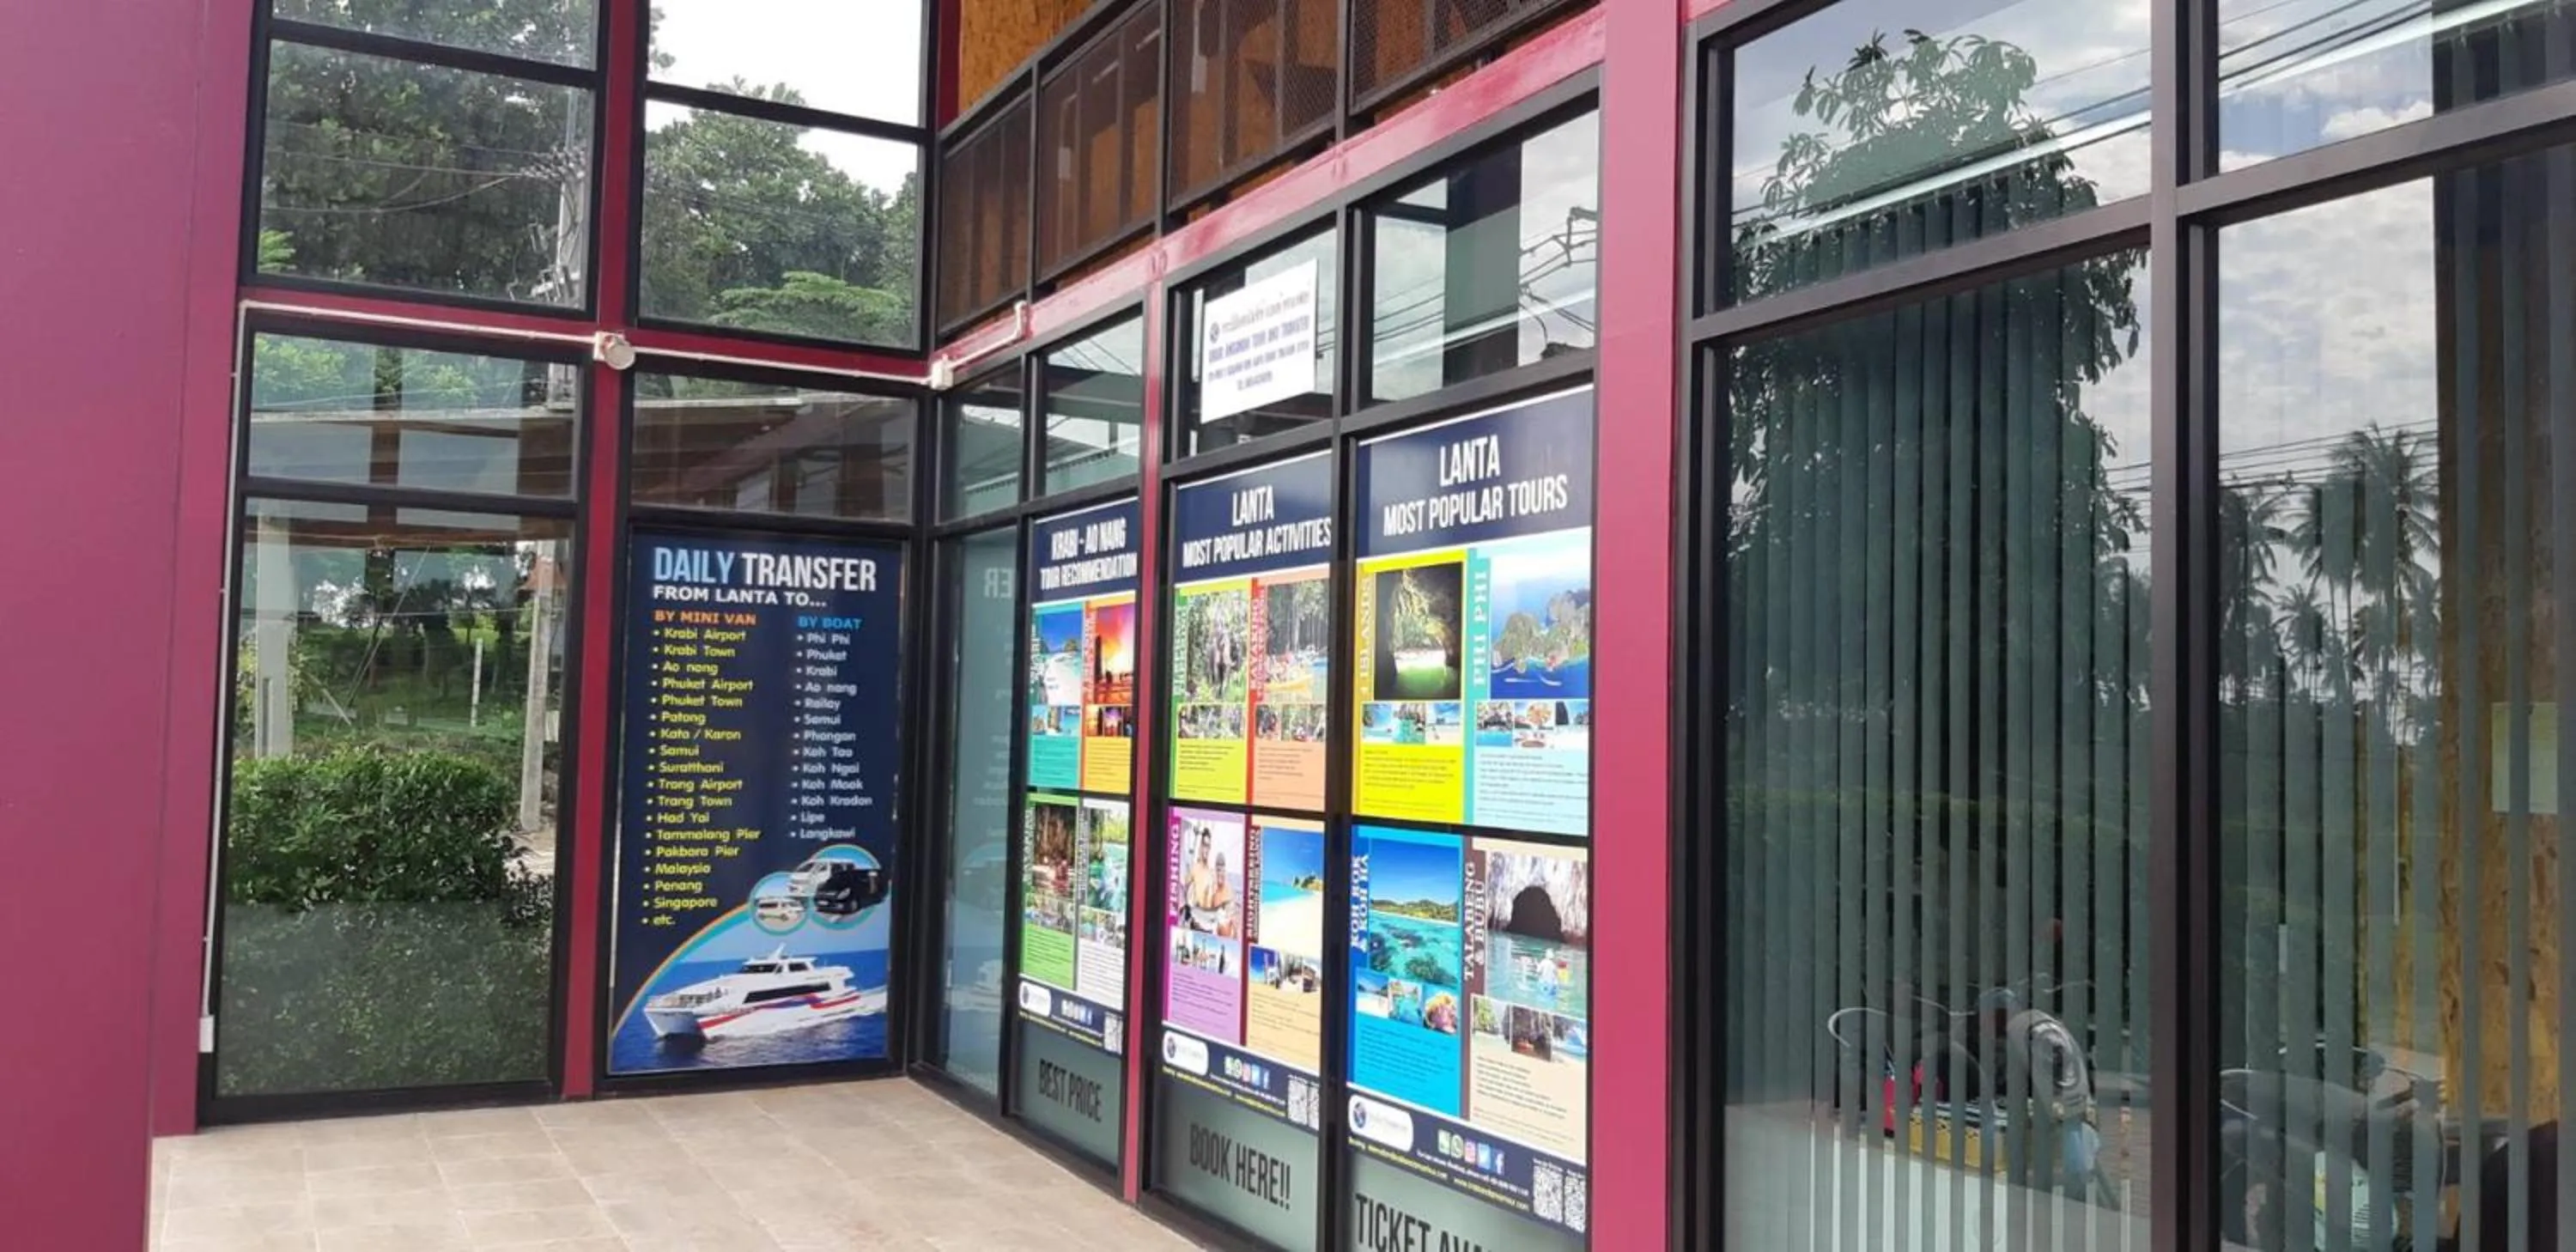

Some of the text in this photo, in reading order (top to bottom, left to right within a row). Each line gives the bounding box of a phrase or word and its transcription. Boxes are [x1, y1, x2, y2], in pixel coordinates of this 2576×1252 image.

[1439, 434, 1500, 487] LANTA
[1232, 484, 1274, 526] LANTA
[1383, 474, 1568, 537] MOST POPULAR TOURS
[1051, 527, 1078, 560] KRABI
[1084, 524, 1098, 555] AO
[1099, 517, 1127, 552] NANG
[1182, 517, 1332, 568] MOST POPULAR ACTIVITIES
[653, 547, 877, 591] DAILY TRANSFER
[1040, 566, 1060, 591] TOUR
[653, 585, 827, 607] FROM LANTA TO...
[654, 611, 756, 625] BY MINI VAN
[798, 617, 862, 629] BY BOAT
[1359, 578, 1372, 678] ISLANDS
[1473, 571, 1487, 685] PHI PHI
[664, 628, 746, 642] Krabi Airport
[806, 633, 850, 645] Phi Phi
[663, 645, 735, 657] Krabi Town
[806, 650, 847, 660] Phuket
[663, 662, 719, 676] Ao nang
[805, 666, 837, 676] Krabi
[663, 678, 753, 692] Phuket Airport
[805, 683, 857, 696] Ao nang
[662, 695, 743, 707] Phuket Town
[805, 698, 841, 710] Railay
[661, 712, 706, 725] Patong
[803, 714, 841, 725] Samui
[660, 729, 690, 739] Kata
[704, 730, 741, 740] Karon
[803, 731, 856, 742] Phangan
[659, 745, 700, 756] Samui
[802, 747, 853, 757] Koh Tao
[659, 763, 724, 773] Suratthani
[802, 763, 860, 775] Koh Ngai
[659, 780, 743, 792] Trang Airport
[801, 780, 824, 789] Koh
[659, 796, 732, 808] Trang Town
[801, 796, 872, 805] Koh Kradan
[657, 813, 709, 824] Had Yai
[800, 812, 824, 824] Lipe
[656, 829, 761, 842] Tammalang Pier
[799, 828, 855, 840] Langkawi
[656, 846, 739, 857] Pakbara Pier
[655, 864, 711, 876] Malaysia
[1170, 824, 1179, 916] FISHING
[654, 881, 702, 892] Penang
[653, 898, 718, 910] Singapore
[1474, 881, 1485, 943] BUBU
[653, 915, 676, 925] etc.
[1464, 862, 1475, 982] TALABENG
[1039, 1058, 1103, 1122] BEST PRICE
[1190, 1122, 1231, 1183] BOOK
[1235, 1142, 1291, 1210] HERE!!
[1355, 1193, 1431, 1252] TICKET
